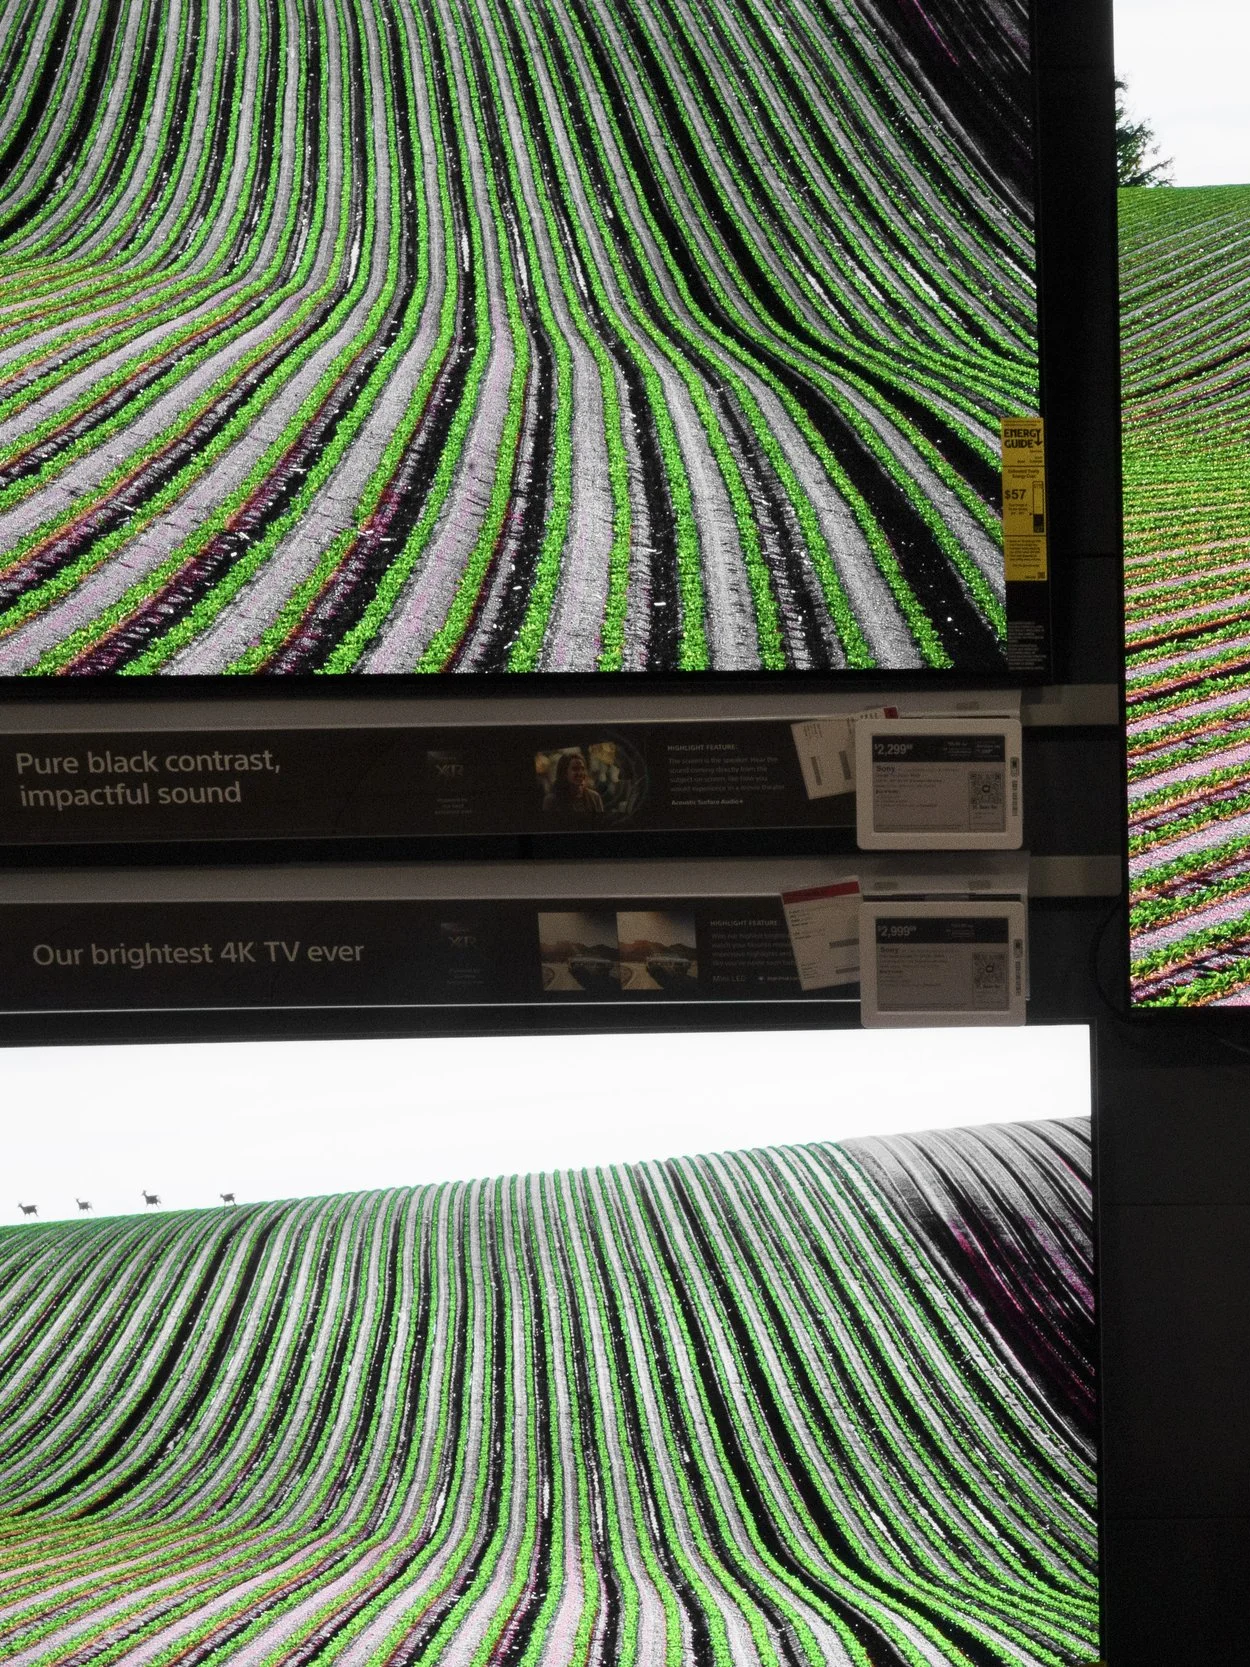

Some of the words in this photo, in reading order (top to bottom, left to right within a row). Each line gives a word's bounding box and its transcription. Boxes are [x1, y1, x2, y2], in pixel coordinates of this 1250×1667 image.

[1004, 428, 1042, 438] ENERGY
[1004, 439, 1034, 449] GUIDE
[1004, 489, 1027, 499] $57
[15, 752, 79, 775] Pure
[87, 750, 159, 774] black
[165, 750, 281, 774] contrast,
[19, 782, 151, 812] impactful
[157, 781, 242, 804] sound
[32, 944, 83, 966] Our
[91, 943, 214, 970] brightest
[220, 941, 256, 963] 4K
[263, 940, 301, 962] TV
[307, 945, 365, 962] ever
